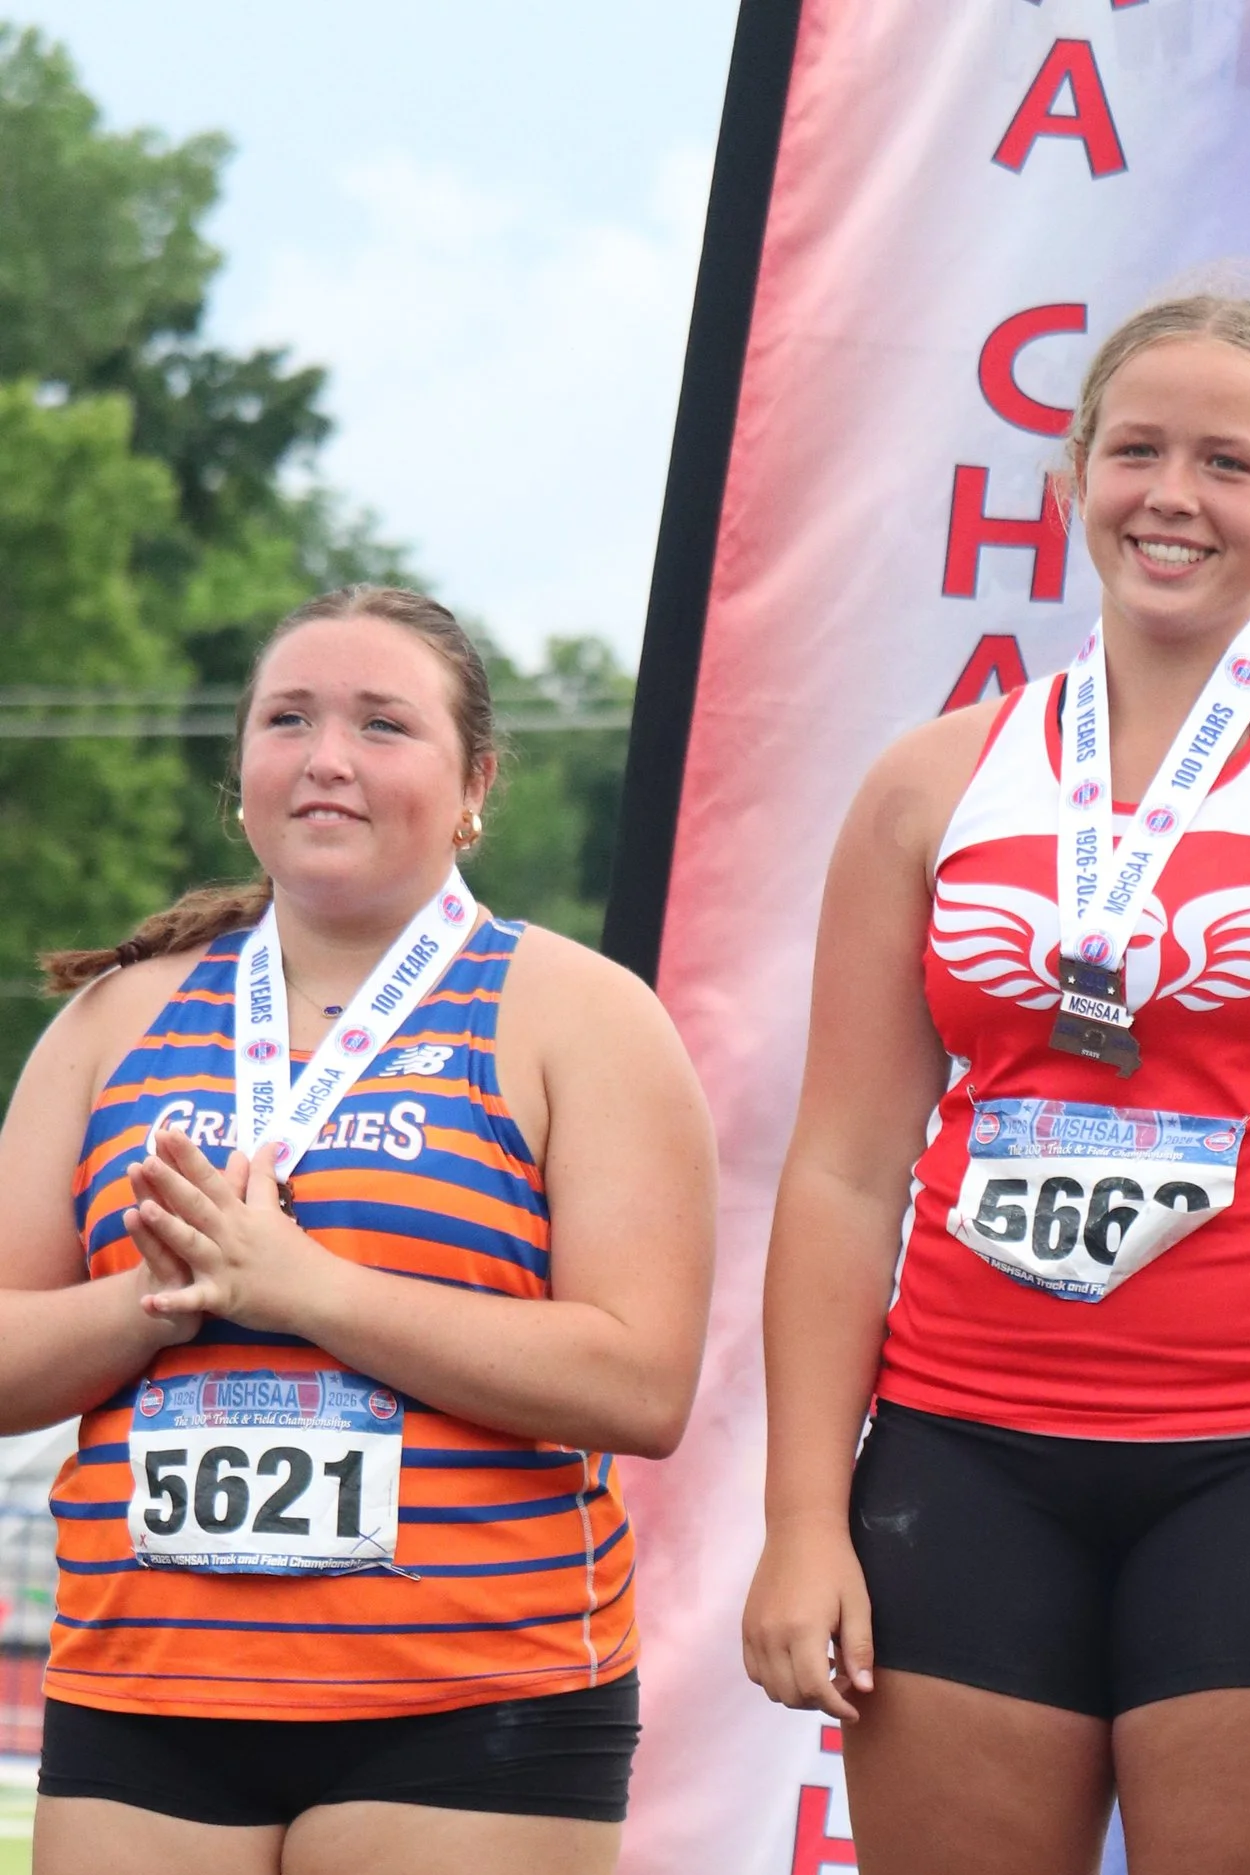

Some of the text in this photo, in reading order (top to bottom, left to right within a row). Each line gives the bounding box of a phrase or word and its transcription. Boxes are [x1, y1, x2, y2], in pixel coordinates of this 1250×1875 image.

[1075, 675, 1097, 763] 100 YEARS
[1171, 702, 1234, 790] 100 YEARS
[1103, 850, 1153, 915] MSHSAA
[249, 945, 272, 1024] 100 YEARS
[370, 933, 440, 1016] 100 YEARS
[1069, 995, 1120, 1024] MSHSAA
[290, 1067, 345, 1126] MSHSAA
[146, 1100, 426, 1161] GRILIES
[1048, 1142, 1073, 1155] Track
[1074, 1144, 1087, 1155] &
[1052, 1117, 1134, 1145] MSHSAA
[991, 1258, 1035, 1283] MSHSAA
[1036, 1277, 1066, 1292] Track
[1067, 1283, 1088, 1294] and
[173, 1391, 195, 1407] 1926
[218, 1383, 299, 1408] MSHSAA
[327, 1392, 358, 1408] 2026
[174, 1415, 188, 1427] The
[214, 1412, 239, 1426] Track
[240, 1414, 252, 1425] &
[253, 1413, 276, 1426] Field
[278, 1413, 352, 1431] Championships
[144, 1445, 364, 1538] 5621
[171, 1555, 209, 1566] MSHSAA
[211, 1555, 236, 1566] Track
[237, 1554, 259, 1565] and
[261, 1555, 287, 1567] Field
